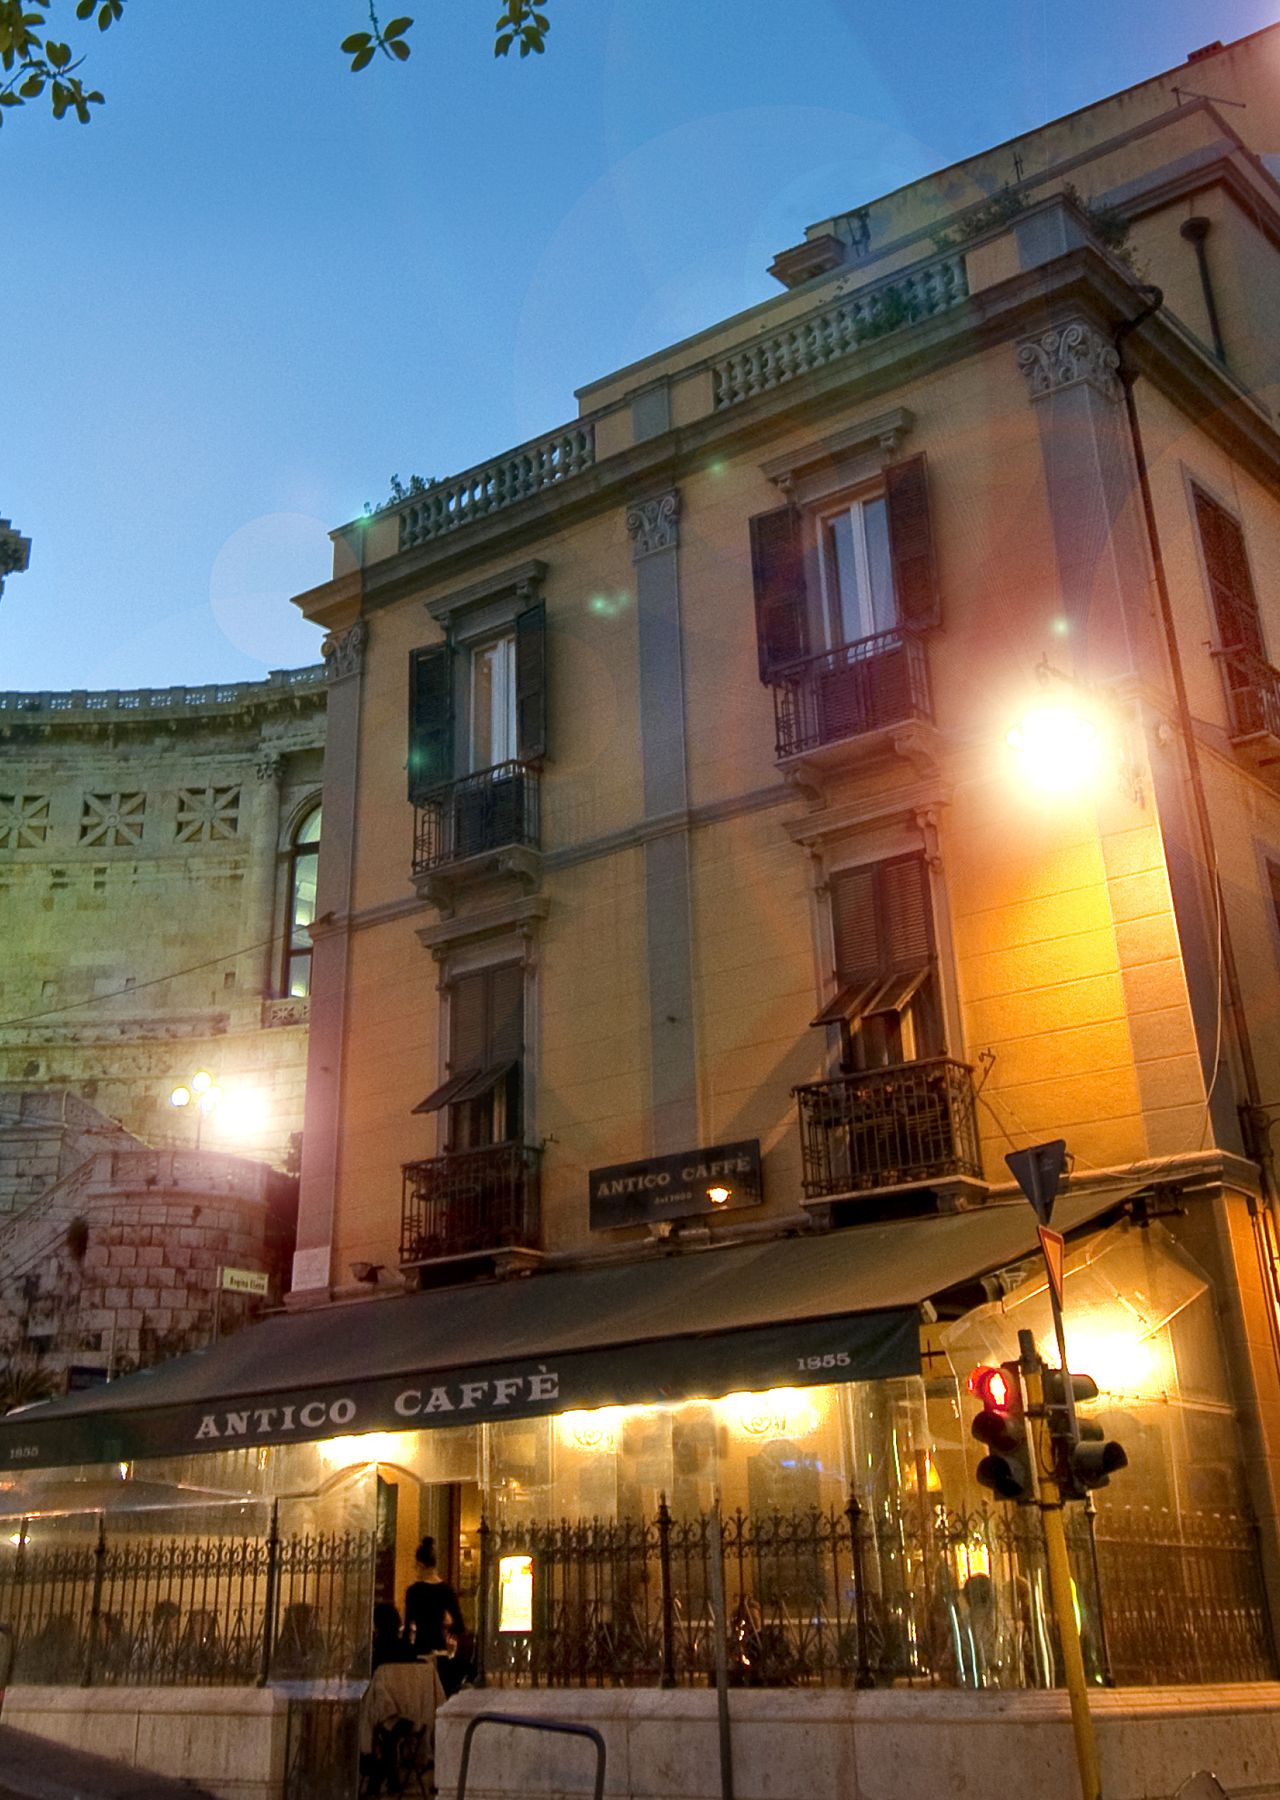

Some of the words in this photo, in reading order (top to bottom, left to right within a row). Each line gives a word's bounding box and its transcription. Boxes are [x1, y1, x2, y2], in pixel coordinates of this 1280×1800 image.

[597, 1172, 670, 1198] ANTICO
[682, 1152, 751, 1181] CAFFÈ
[797, 1352, 851, 1371] 1855
[194, 1397, 358, 1440] ANTICO
[393, 1364, 560, 1417] CAFFÈ
